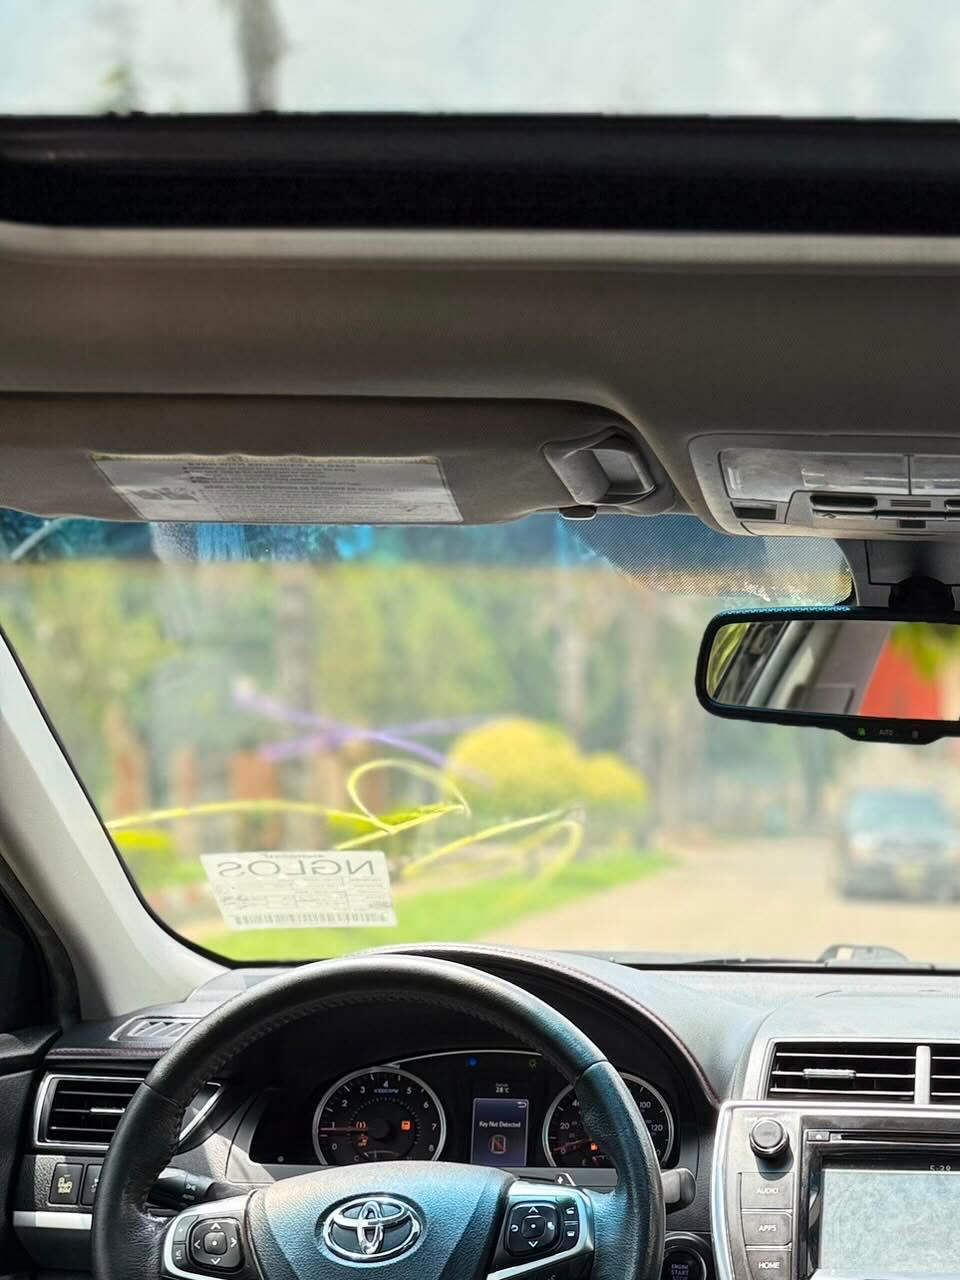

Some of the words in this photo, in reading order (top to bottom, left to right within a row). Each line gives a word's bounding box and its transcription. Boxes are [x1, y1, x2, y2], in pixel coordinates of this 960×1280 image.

[406, 1087, 412, 1095] 5
[342, 1099, 348, 1107] 2
[572, 1099, 579, 1107] 4
[431, 1122, 438, 1130] 7
[560, 1122, 570, 1130] 20
[650, 1124, 663, 1132] 120
[331, 1143, 338, 1151] 0
[758, 1224, 777, 1232] APPS
[758, 1261, 780, 1269] HOME
